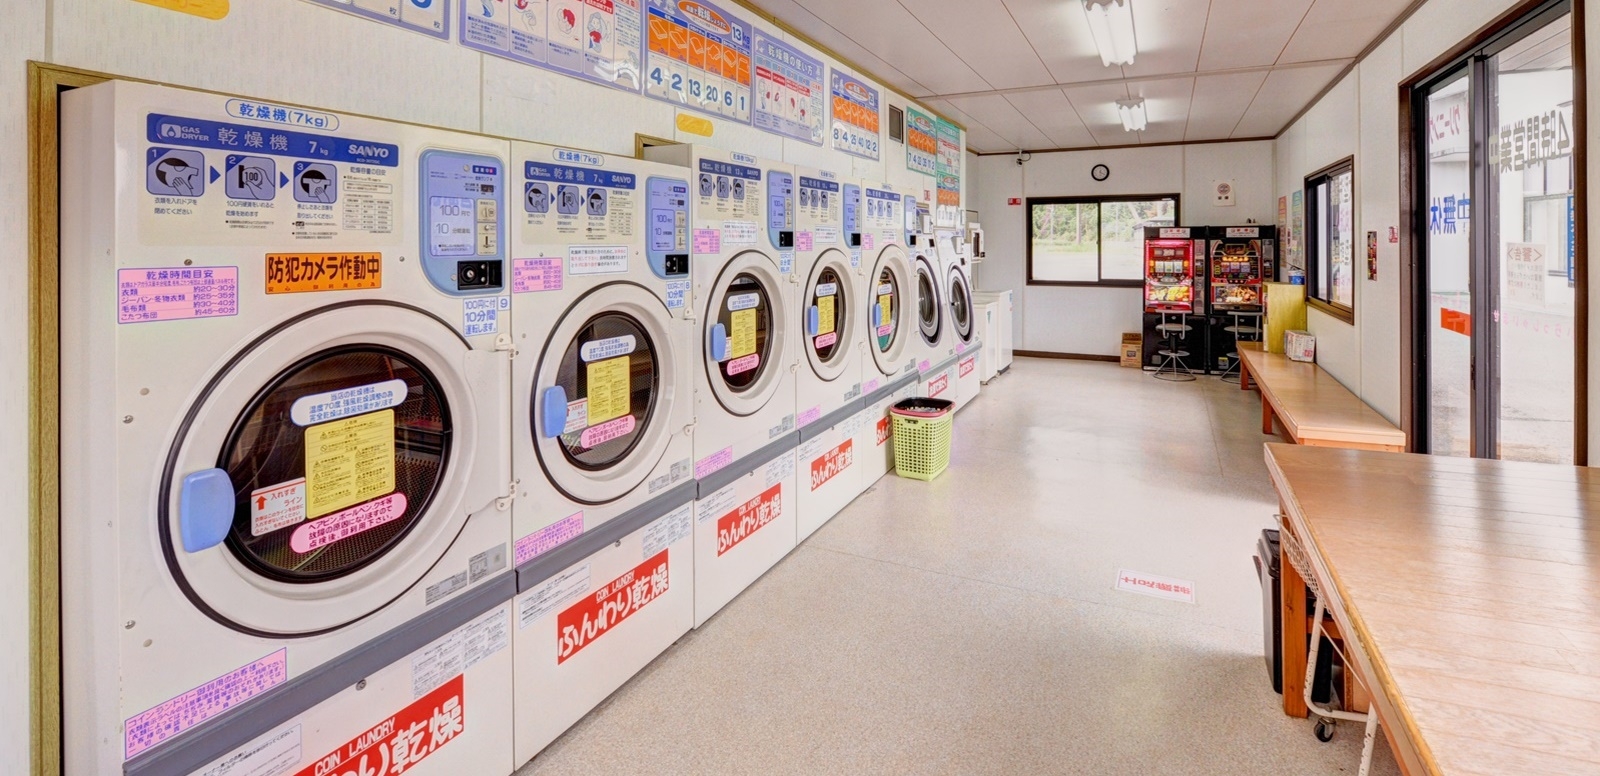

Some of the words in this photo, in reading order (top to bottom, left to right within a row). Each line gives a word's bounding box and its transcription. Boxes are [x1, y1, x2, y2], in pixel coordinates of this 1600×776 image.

[732, 26, 742, 42] 13
[650, 67, 663, 86] 4
[671, 73, 683, 92] 2
[689, 78, 701, 98] 13
[706, 84, 718, 103] 20
[724, 90, 733, 107] 6
[739, 96, 745, 111] 1
[239, 102, 329, 129] 乾燥機(7kg)
[181, 126, 201, 135] GAS
[181, 133, 210, 143] DRYER
[217, 128, 289, 152] 乾燥機
[308, 141, 318, 154] 7
[319, 148, 329, 157] kg
[348, 144, 390, 158] SANYO
[833, 128, 839, 140] 8
[842, 131, 849, 144] 4
[872, 141, 877, 153] 2
[151, 149, 157, 158] 1
[229, 157, 236, 165] 2
[297, 163, 304, 171] 3
[245, 172, 259, 182] 100
[553, 167, 586, 183] 乾燥機
[611, 175, 633, 185] SANYO
[439, 204, 460, 217] 100
[435, 223, 450, 235] 10
[146, 269, 214, 281] 乾燥時間目安
[267, 255, 380, 284] 防犯カメラ作動中
[121, 288, 138, 297] 衣類
[121, 304, 147, 313] 毛布類
[464, 297, 497, 310] 100円に付
[500, 298, 508, 308] 9
[121, 312, 158, 321] こたつ布団
[464, 309, 497, 323] 10分間
[811, 446, 853, 490] ふんわり乾燥
[271, 487, 297, 501] 入れすぎ
[284, 496, 304, 508] ライン
[308, 504, 394, 541] 故障の原因になりますので
[718, 493, 782, 553] ふんわり乾燥
[595, 586, 610, 603] COIN
[612, 569, 636, 593] LAUNDRY
[558, 562, 670, 659] ふんわり乾燥
[314, 750, 342, 776] COIN
[348, 716, 396, 759] LAUNDRY
